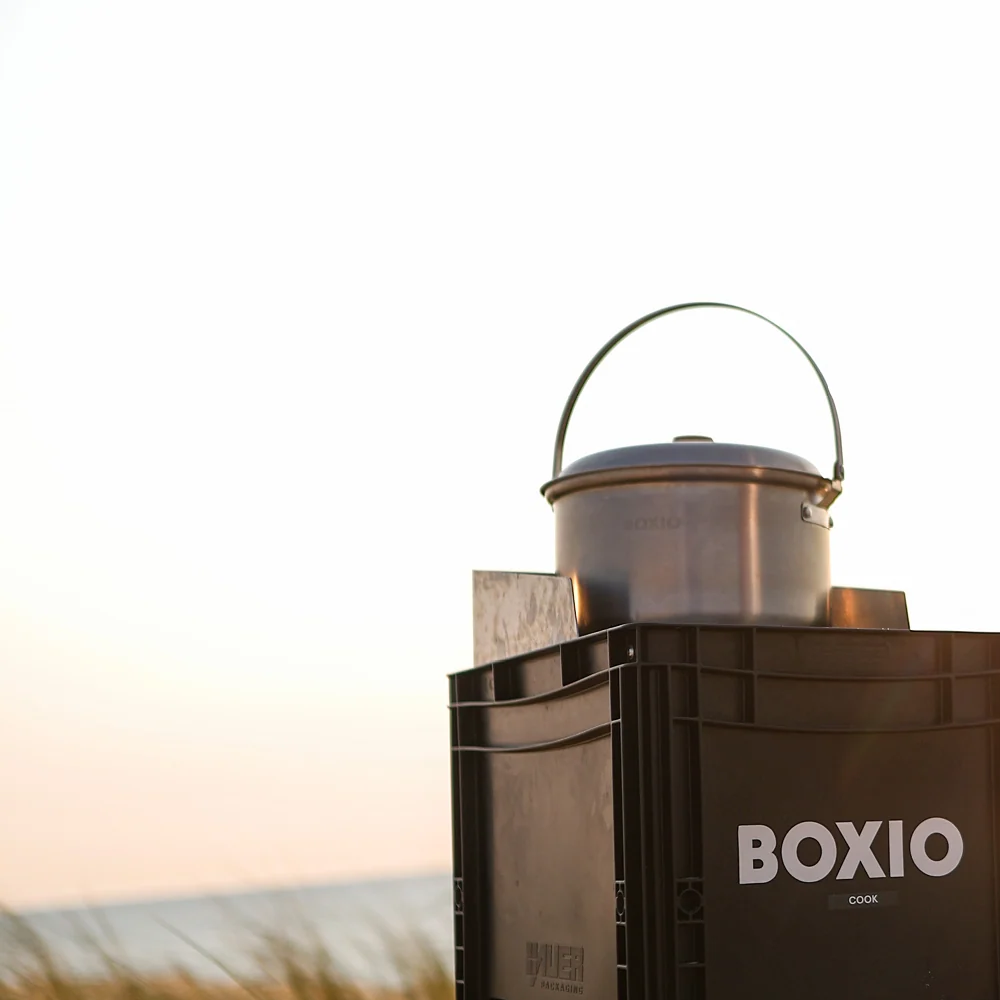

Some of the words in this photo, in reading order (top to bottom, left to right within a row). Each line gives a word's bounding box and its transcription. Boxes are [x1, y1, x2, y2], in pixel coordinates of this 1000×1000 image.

[737, 816, 964, 884] BOXIO
[848, 894, 878, 905] COOK
[541, 980, 584, 995] PACKAGING
